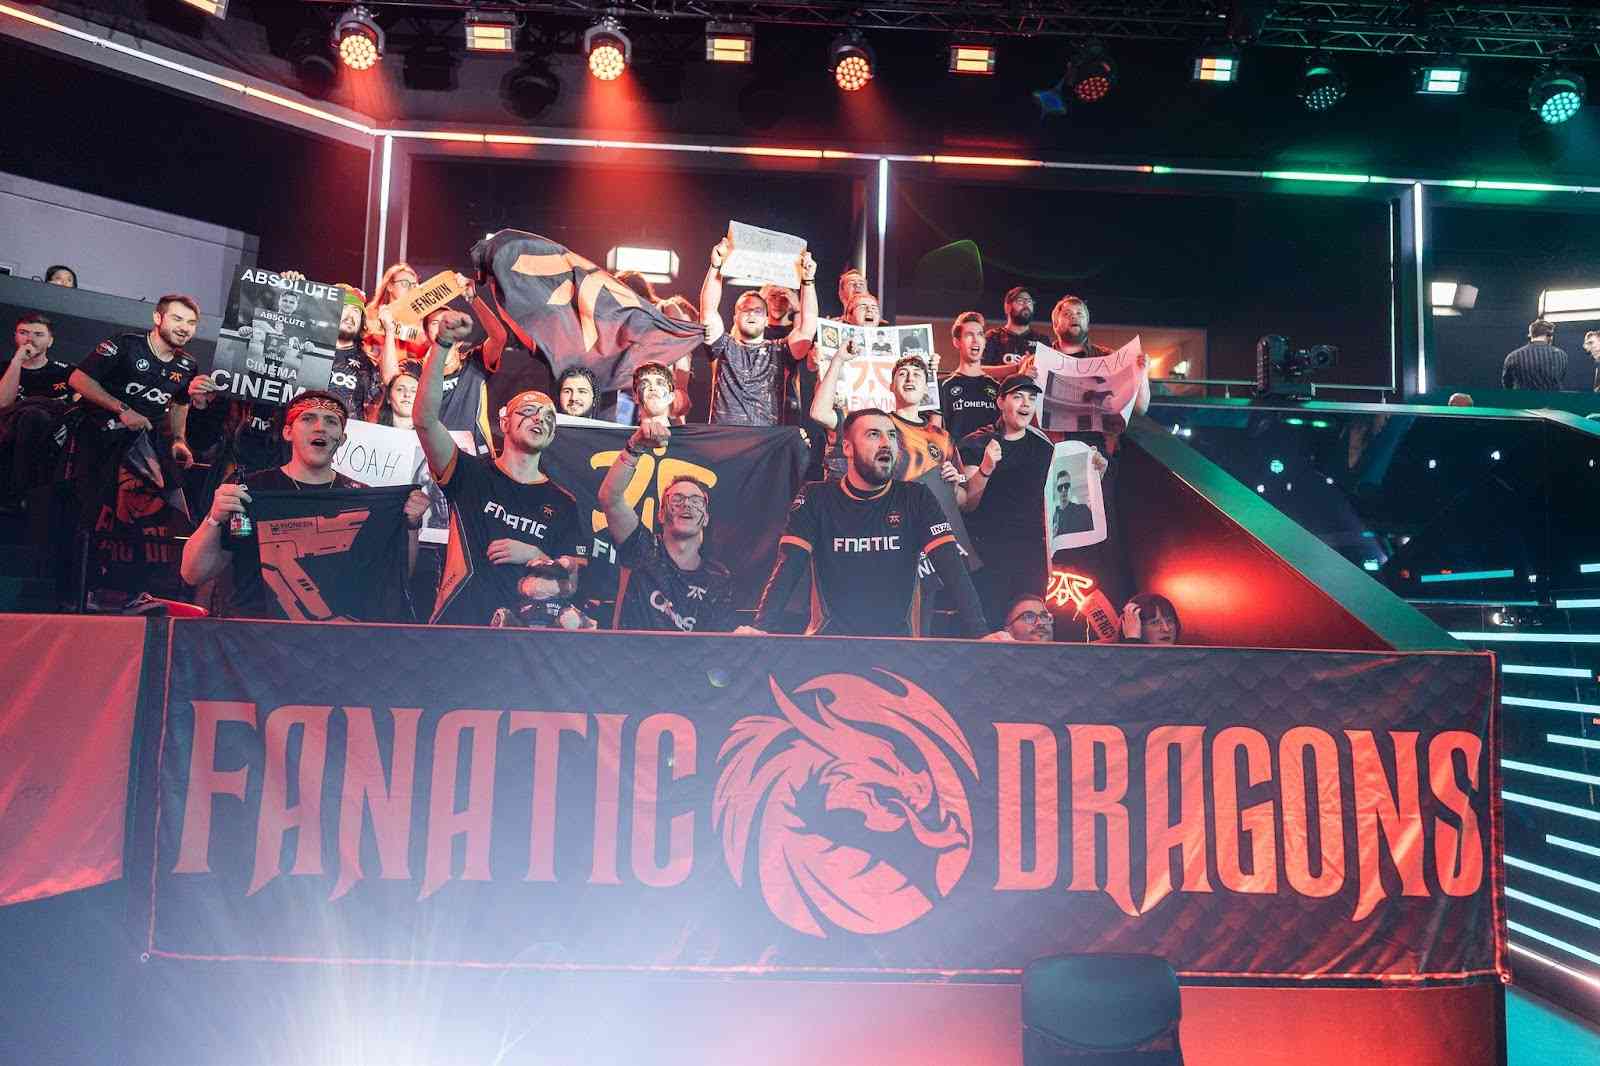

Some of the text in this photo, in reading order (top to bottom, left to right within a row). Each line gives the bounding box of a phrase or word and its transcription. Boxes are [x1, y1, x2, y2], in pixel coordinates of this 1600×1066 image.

[241, 268, 339, 301] ABSOLUTE
[410, 282, 453, 314] #FNCWIN
[260, 311, 305, 328] ABSOLUTE
[245, 358, 298, 380] CINEMA
[210, 369, 307, 404] CINEM
[963, 400, 997, 409] ONEPLU
[483, 500, 548, 540] FNATIC
[833, 536, 900, 552] FNATIC
[171, 699, 1485, 922] FANATIC DRAGONS
